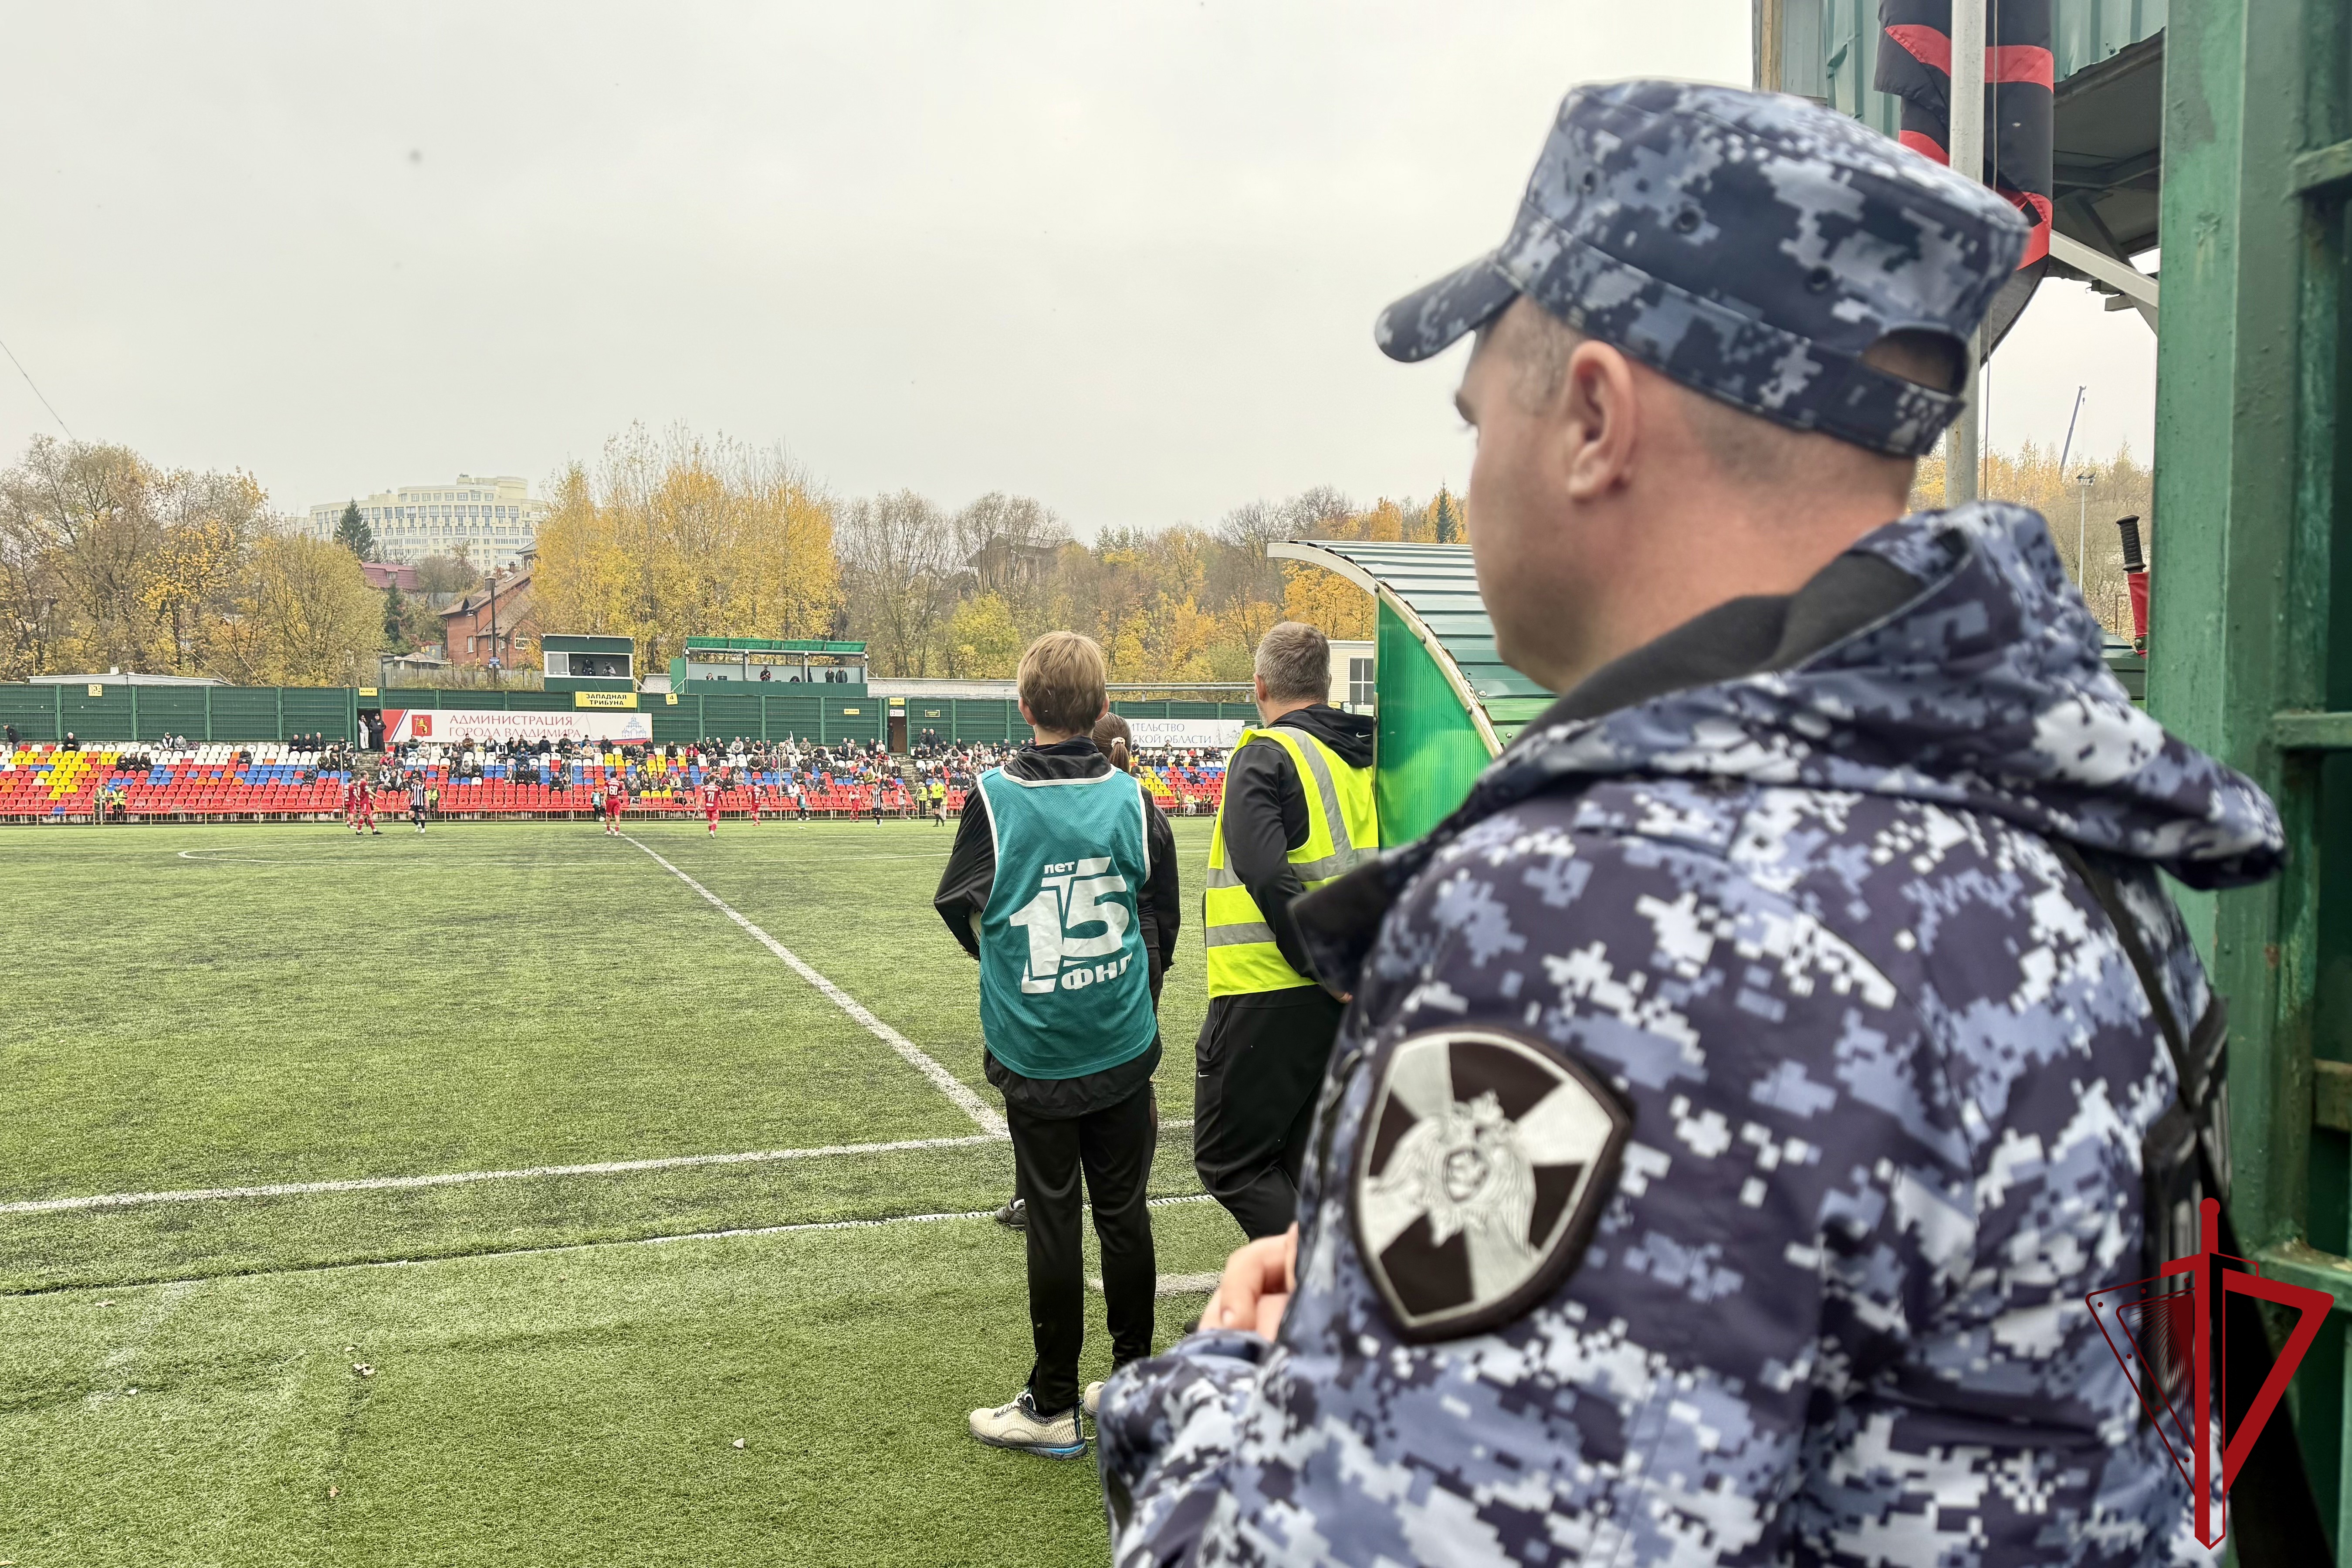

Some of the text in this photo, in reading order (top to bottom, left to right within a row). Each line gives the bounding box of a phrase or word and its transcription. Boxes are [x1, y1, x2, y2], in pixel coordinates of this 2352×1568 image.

[450, 715, 572, 725] АДМИНИСТРАЦИЯ
[450, 728, 581, 738] ГОРОДА ВЛАДИМИРА
[1164, 735, 1211, 744] ОБЛАСТИ
[609, 786, 618, 795] 60
[1044, 861, 1075, 874] лет
[1009, 857, 1130, 993] 15
